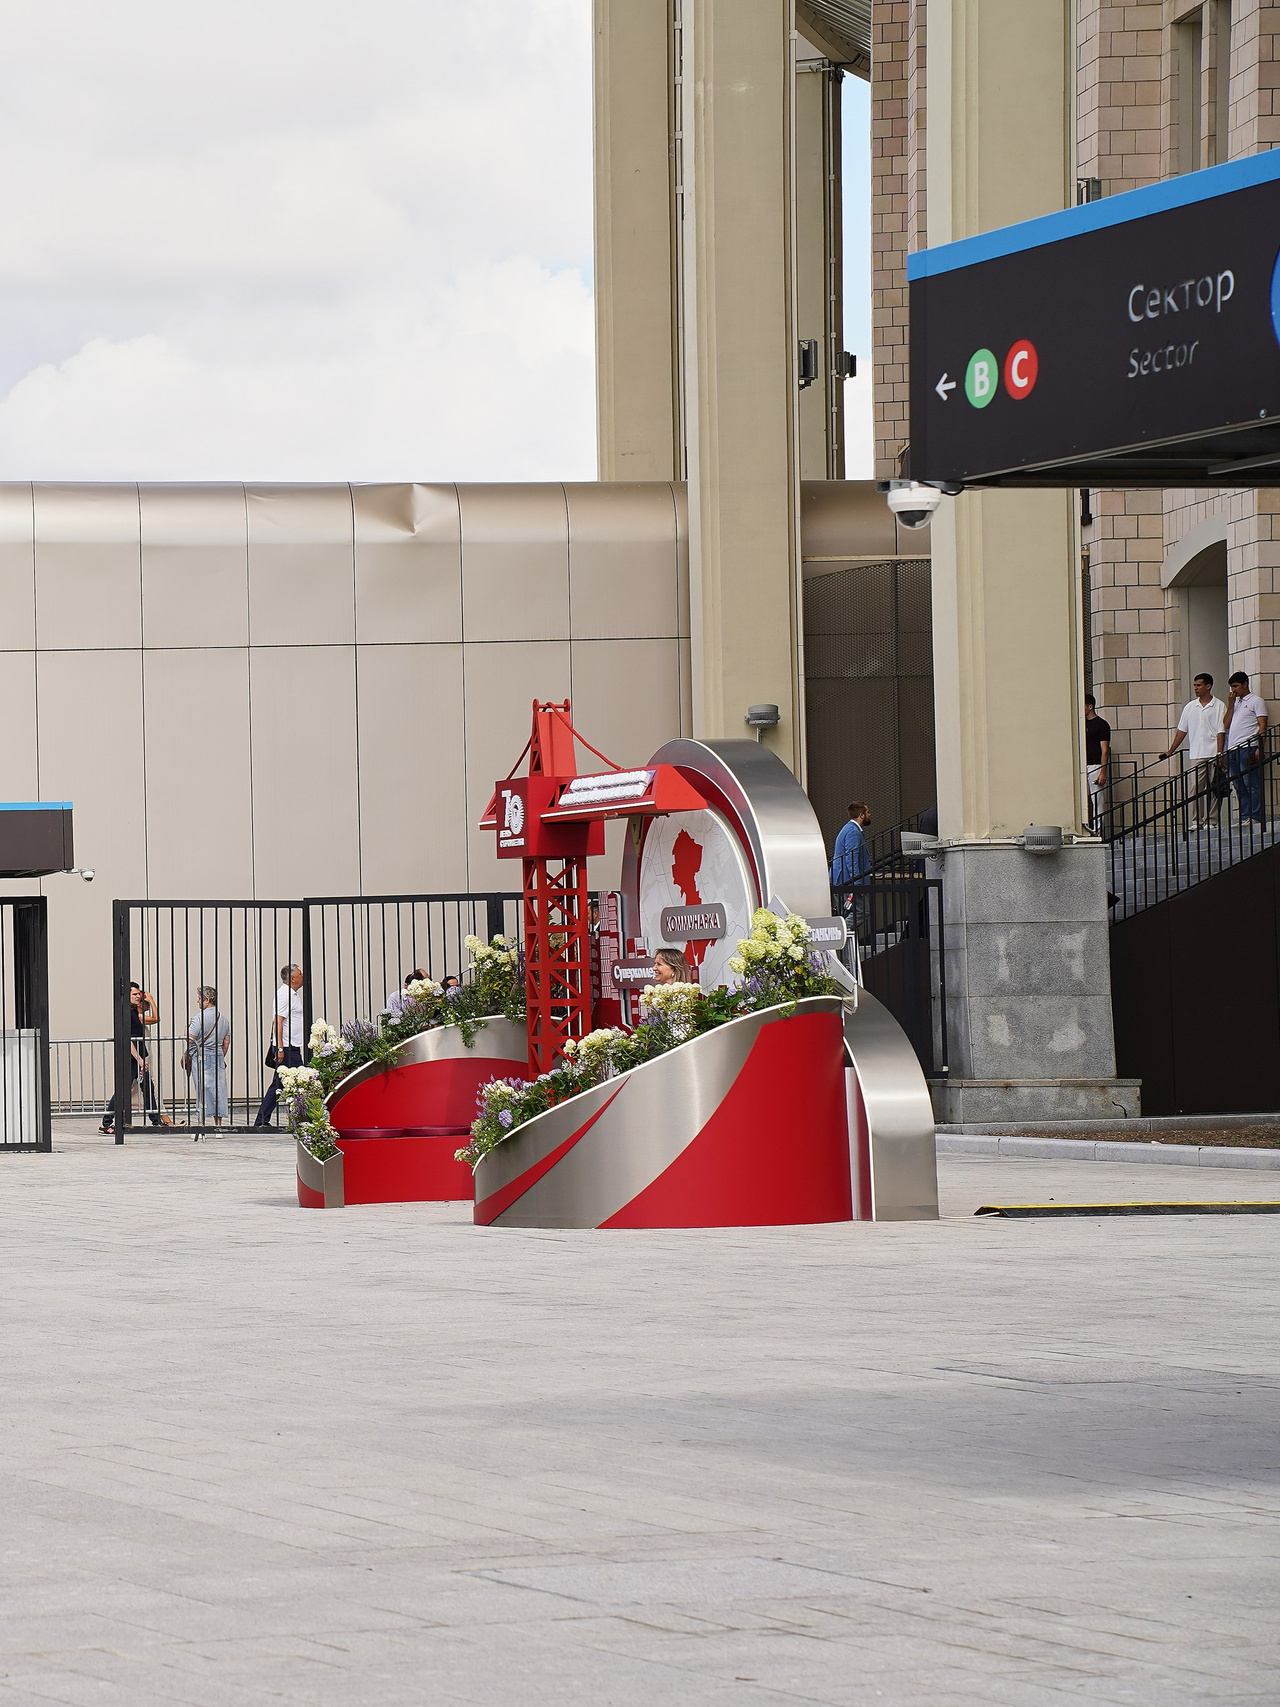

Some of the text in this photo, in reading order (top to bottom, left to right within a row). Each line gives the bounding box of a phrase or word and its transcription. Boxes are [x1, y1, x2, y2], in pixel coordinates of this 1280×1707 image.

[1128, 269, 1235, 323] Сектор
[974, 350, 1029, 398] B C
[1127, 340, 1199, 379] Sector
[665, 912, 721, 932] КОММУНАРКА
